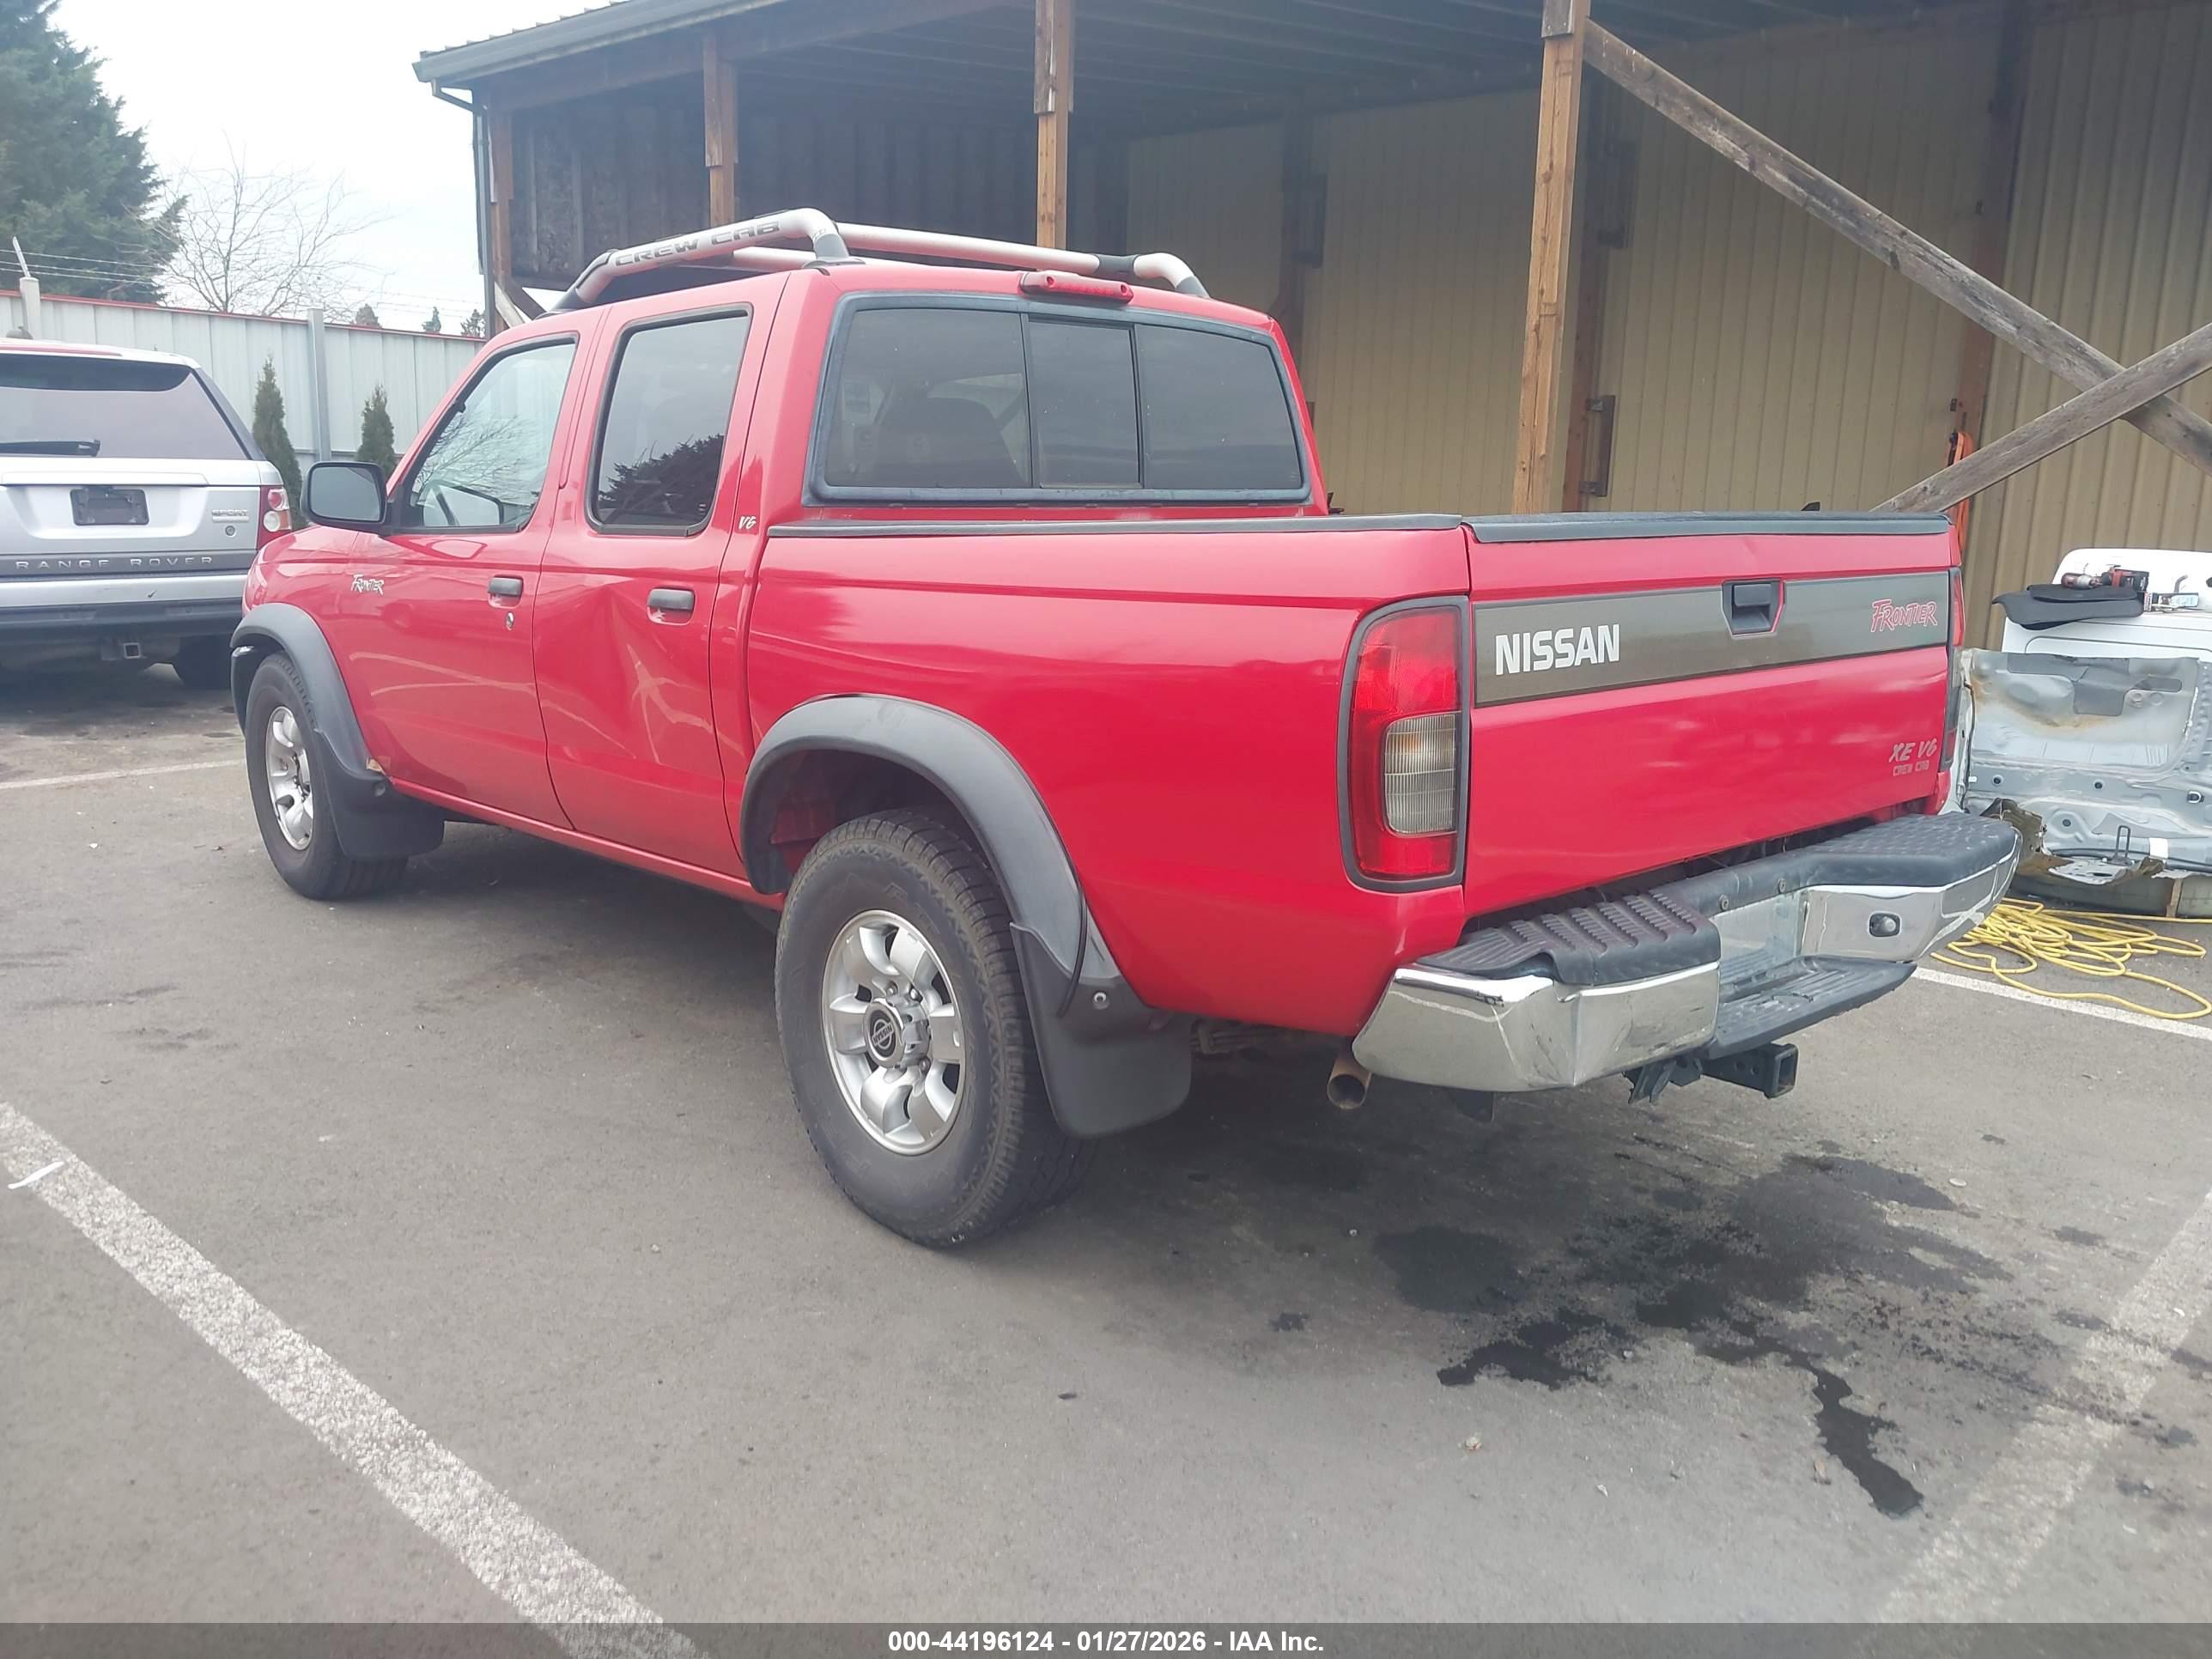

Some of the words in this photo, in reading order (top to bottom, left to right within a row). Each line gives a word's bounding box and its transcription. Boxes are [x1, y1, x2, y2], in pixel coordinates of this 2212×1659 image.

[615, 239, 700, 267] CREW
[711, 221, 780, 246] CAB
[738, 515, 757, 530] V6
[15, 559, 111, 569] RANGE
[130, 556, 213, 567] ROVER
[1495, 623, 1620, 676] NISSAN
[1888, 742, 1916, 763] XE
[1917, 738, 1938, 758] V6
